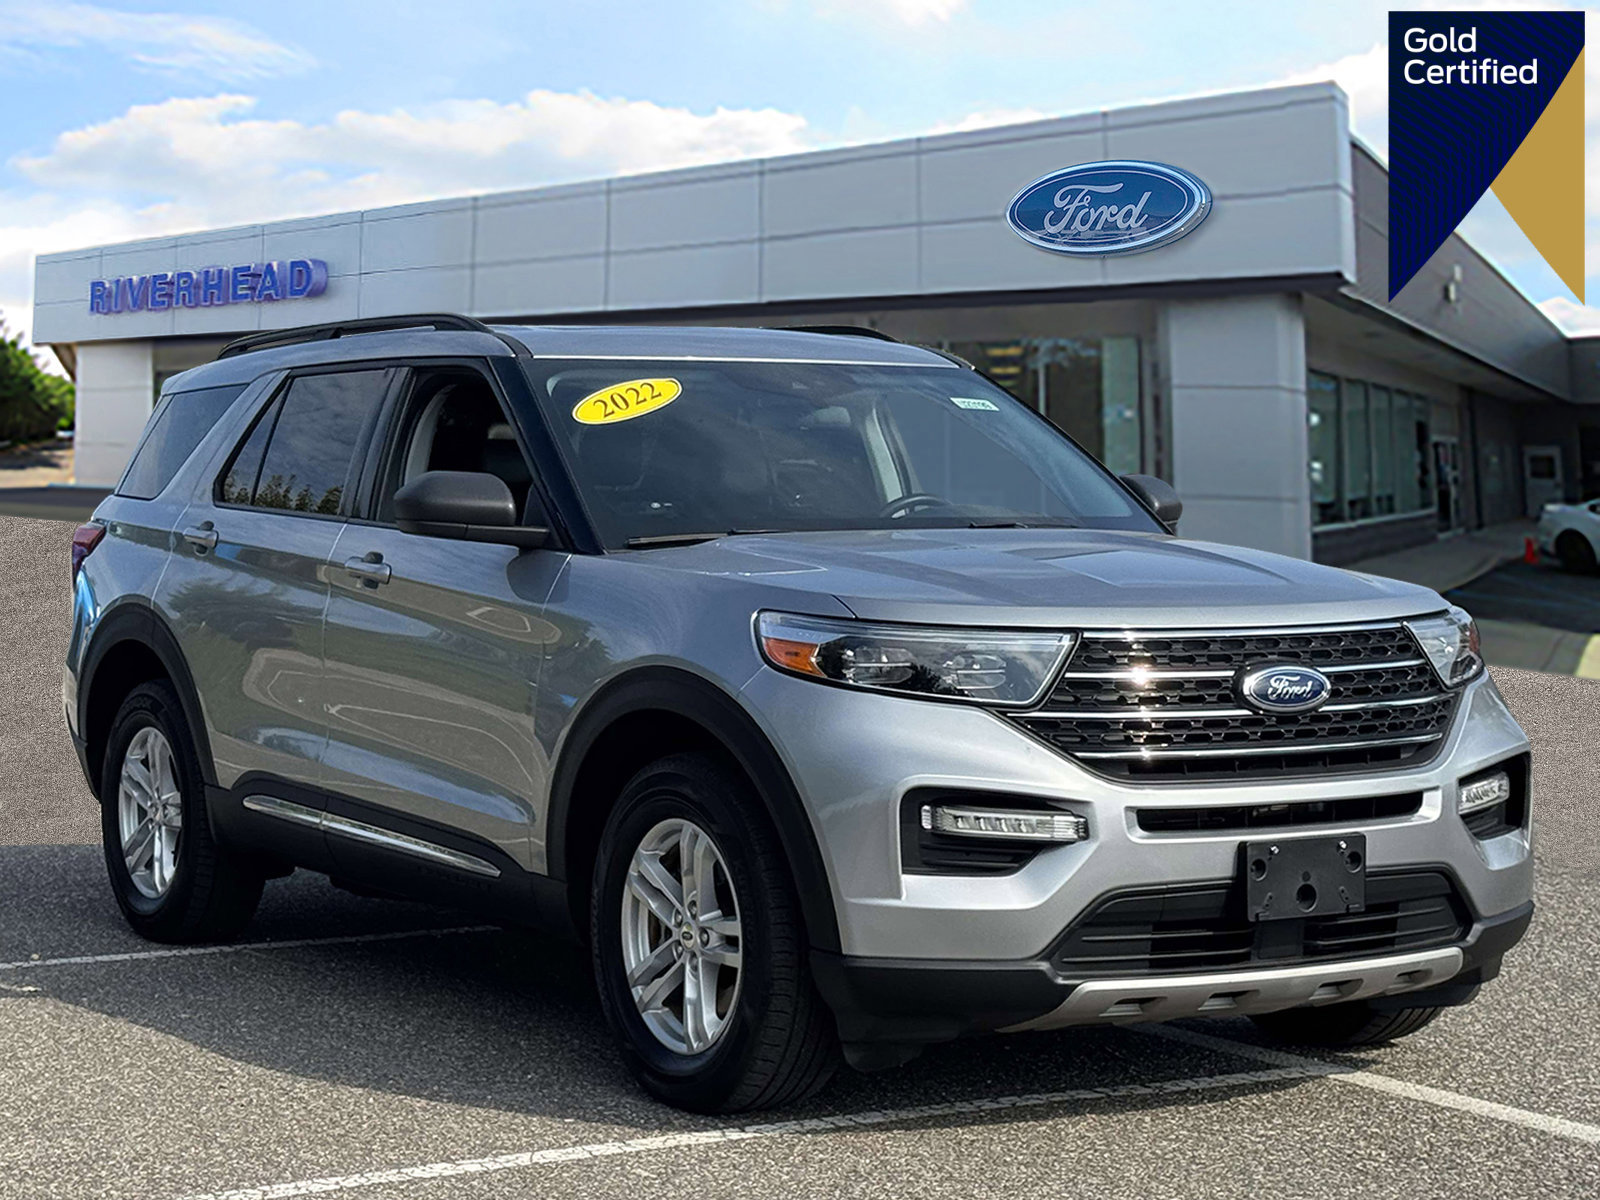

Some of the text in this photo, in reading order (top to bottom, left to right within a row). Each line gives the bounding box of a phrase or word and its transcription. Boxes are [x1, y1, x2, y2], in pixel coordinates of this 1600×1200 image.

[1043, 183, 1152, 234] Ford
[89, 259, 320, 315] RIVERHEAD
[593, 382, 662, 418] 2022
[1267, 675, 1313, 701] Ford
